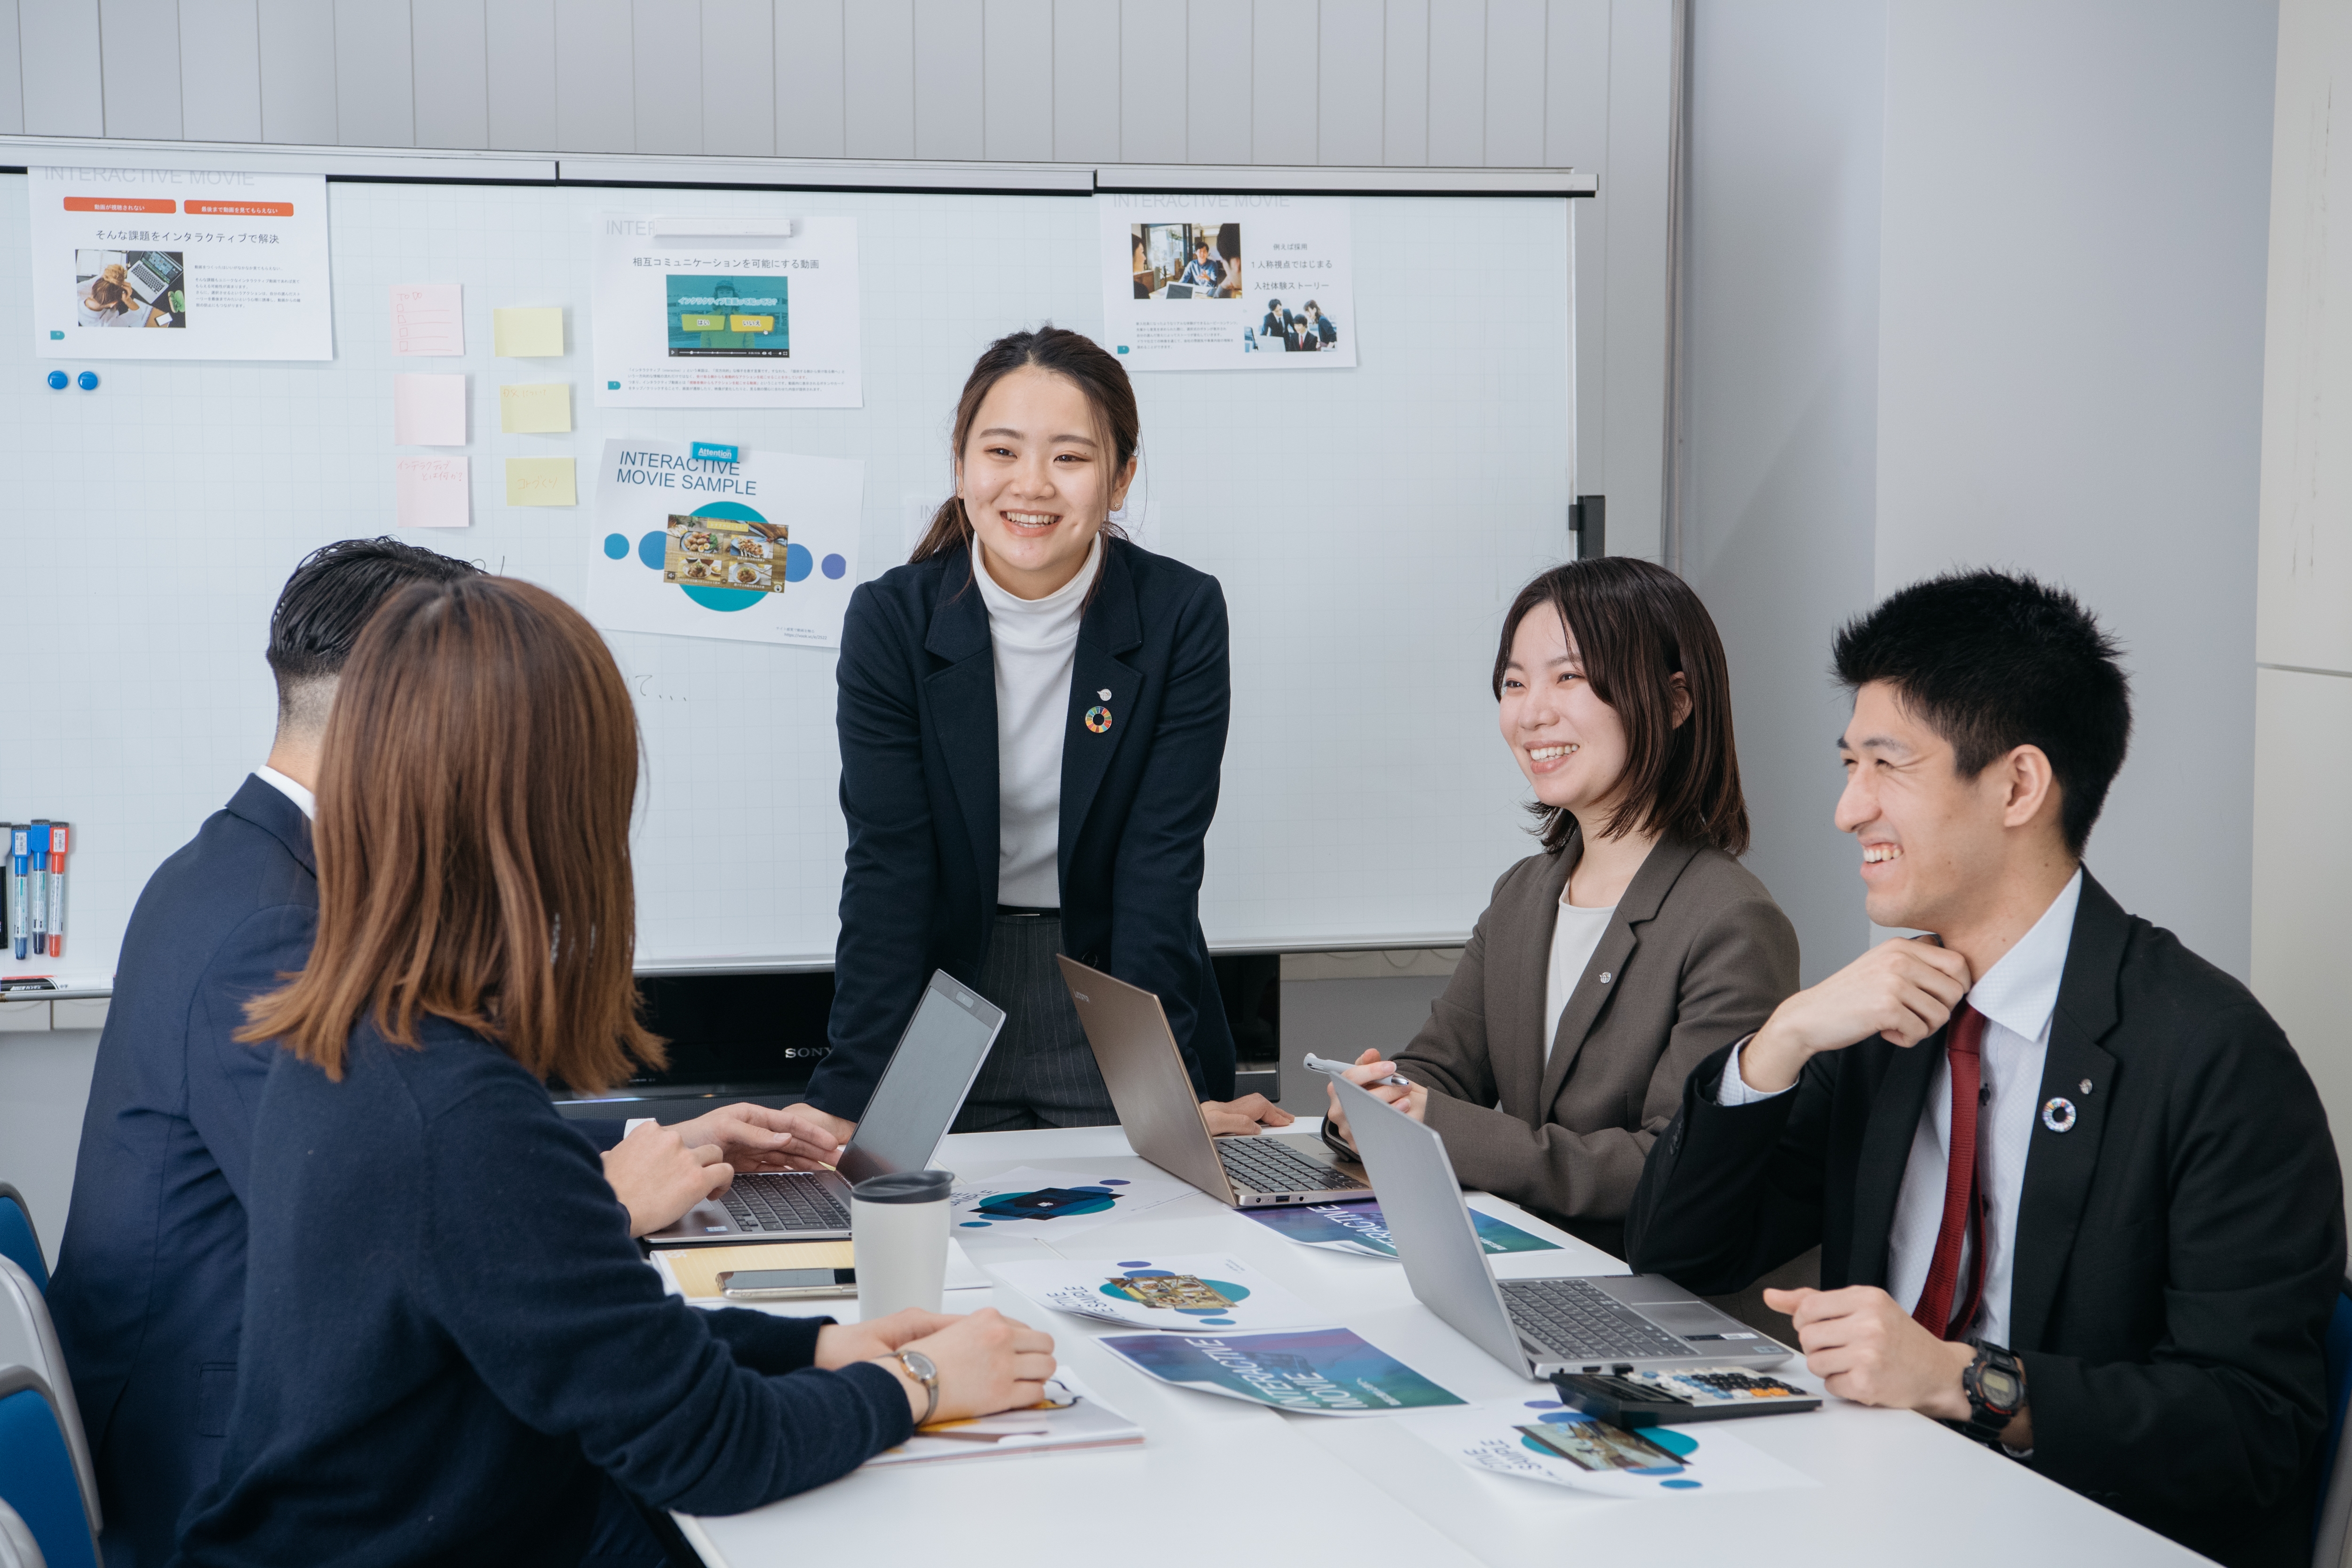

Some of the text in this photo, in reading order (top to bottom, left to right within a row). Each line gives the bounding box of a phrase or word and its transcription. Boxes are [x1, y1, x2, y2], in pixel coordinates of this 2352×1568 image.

[45, 167, 254, 186] INTERACTIVE MOVIE
[1113, 194, 1290, 207] INTERACTIVE MOVIE
[95, 230, 280, 244] そんな課題をインタラクティブで解決
[633, 256, 819, 270] 相互コミュニケーションを可能にする動画
[1254, 281, 1330, 291] 入社体験ストーリー
[698, 447, 732, 458] Attention
[620, 451, 740, 476] INTERACTIVE
[617, 469, 757, 495] MOVIE SAMPLE
[785, 1047, 833, 1059] SONY
[1184, 1337, 1321, 1409] INTERACTIVE
[1282, 1371, 1368, 1409] MOVIE
